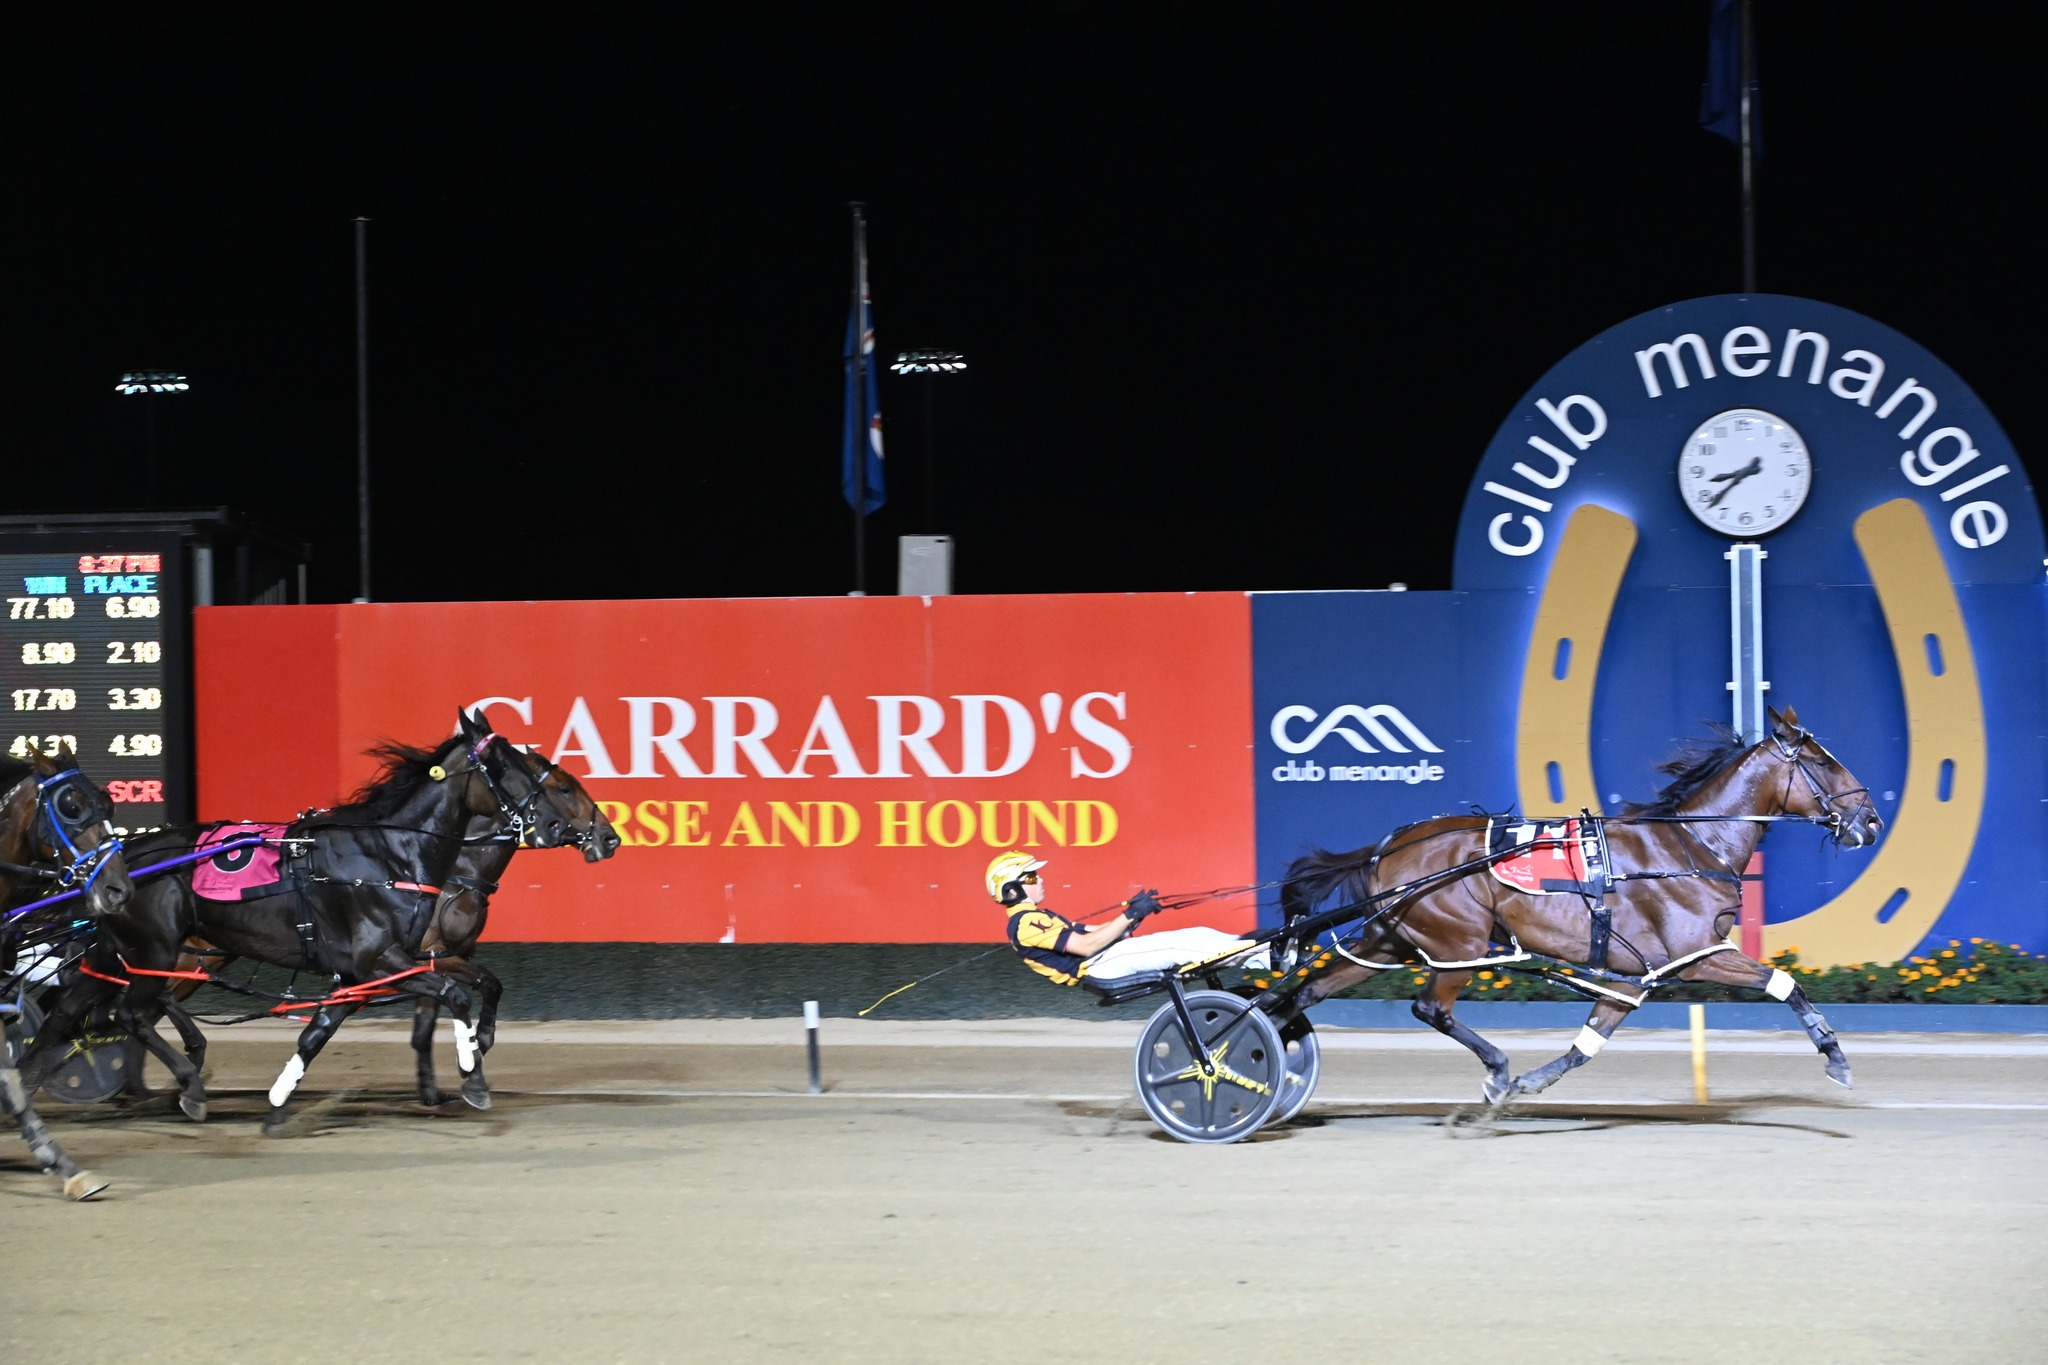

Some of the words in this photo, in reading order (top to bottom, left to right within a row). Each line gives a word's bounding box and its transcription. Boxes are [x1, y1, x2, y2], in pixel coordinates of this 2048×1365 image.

[1483, 393, 1608, 557] club
[1634, 325, 2010, 549] menangle
[1689, 465, 1705, 479] 9
[1737, 511, 1755, 526] 6
[83, 575, 158, 594] PLACE
[6, 597, 75, 620] 77.10
[105, 596, 160, 619] 6.90
[21, 642, 76, 665] 8.90
[106, 641, 161, 664] 2.10
[11, 688, 76, 711] 17.70
[107, 687, 162, 710] 3.30
[9, 735, 77, 757] 4130
[108, 734, 162, 757] 4.90
[453, 691, 1132, 779] GARRARD'S
[1271, 759, 1326, 782] club
[1329, 759, 1446, 785] menangle
[107, 780, 164, 803] SCR
[720, 800, 860, 847] AND
[875, 799, 1119, 848] HOUND
